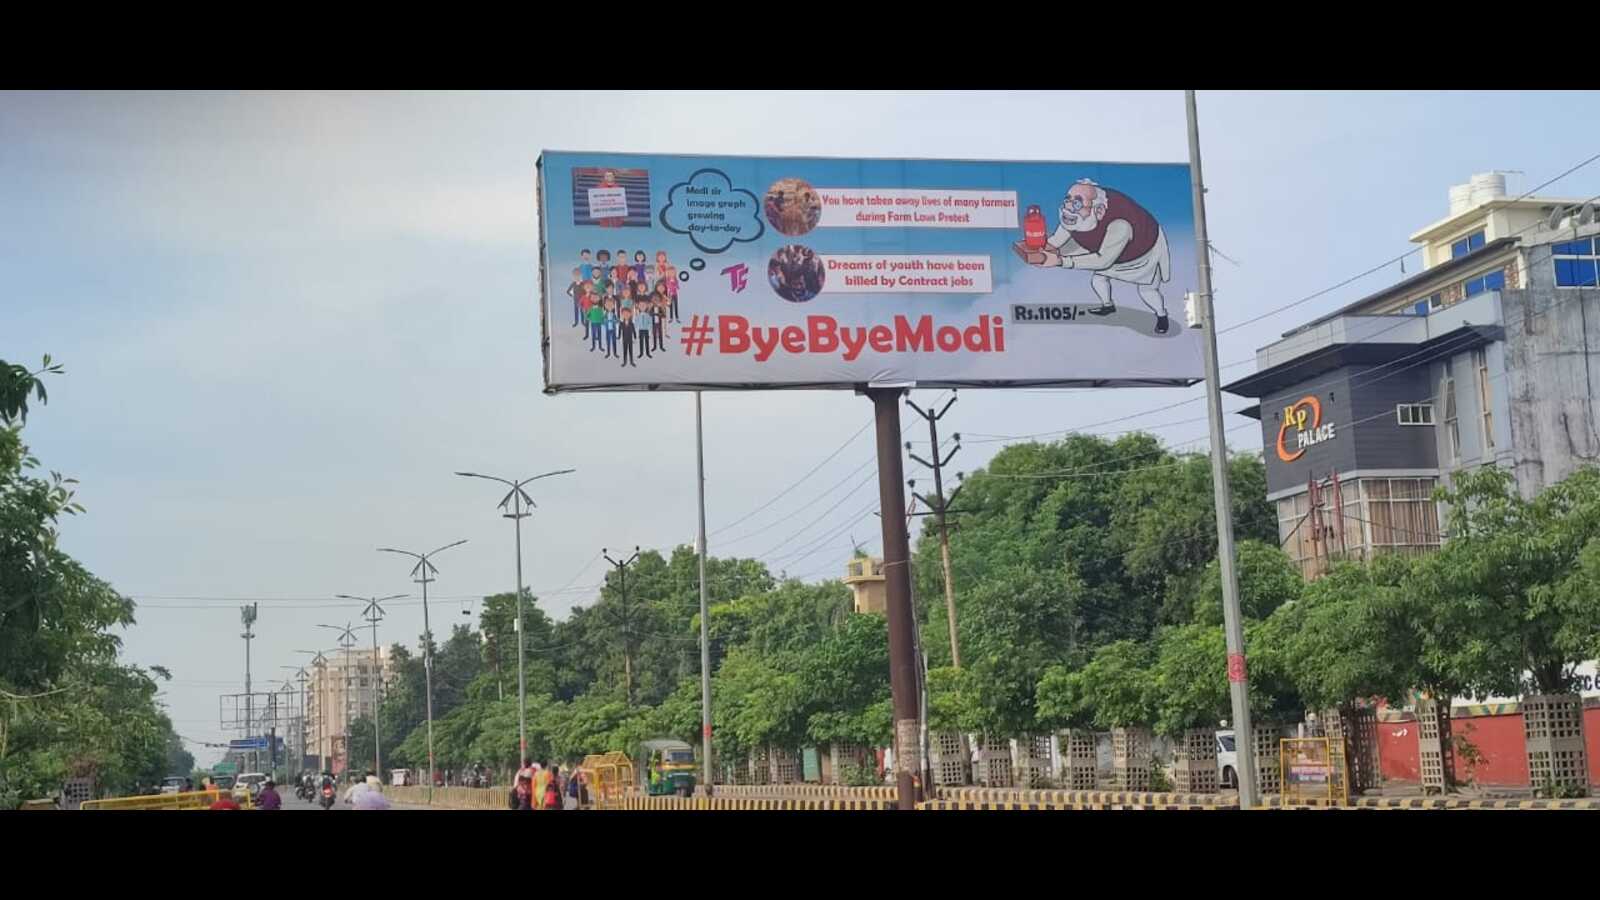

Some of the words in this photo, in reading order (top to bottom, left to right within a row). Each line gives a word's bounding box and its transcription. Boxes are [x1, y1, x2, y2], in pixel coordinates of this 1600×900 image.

[822, 194, 840, 205] You
[842, 194, 864, 205] have
[895, 197, 920, 208] away
[921, 195, 941, 206] lives
[943, 196, 952, 206] of
[954, 198, 979, 208] many
[687, 210, 725, 220] growing
[856, 211, 886, 223] during
[888, 211, 912, 221] Farm
[938, 212, 969, 222] Protest
[688, 223, 742, 233] day-to-day
[828, 259, 872, 270] Dreams
[876, 259, 886, 270] of
[890, 259, 924, 271] youth
[926, 259, 954, 270] have
[957, 259, 985, 270] been
[881, 275, 896, 288] by
[898, 275, 948, 286] Contract
[950, 275, 974, 287] jobs
[681, 314, 1004, 362] #ByeByeModi
[1283, 405, 1307, 431] RP
[1297, 422, 1336, 448] PALACE
